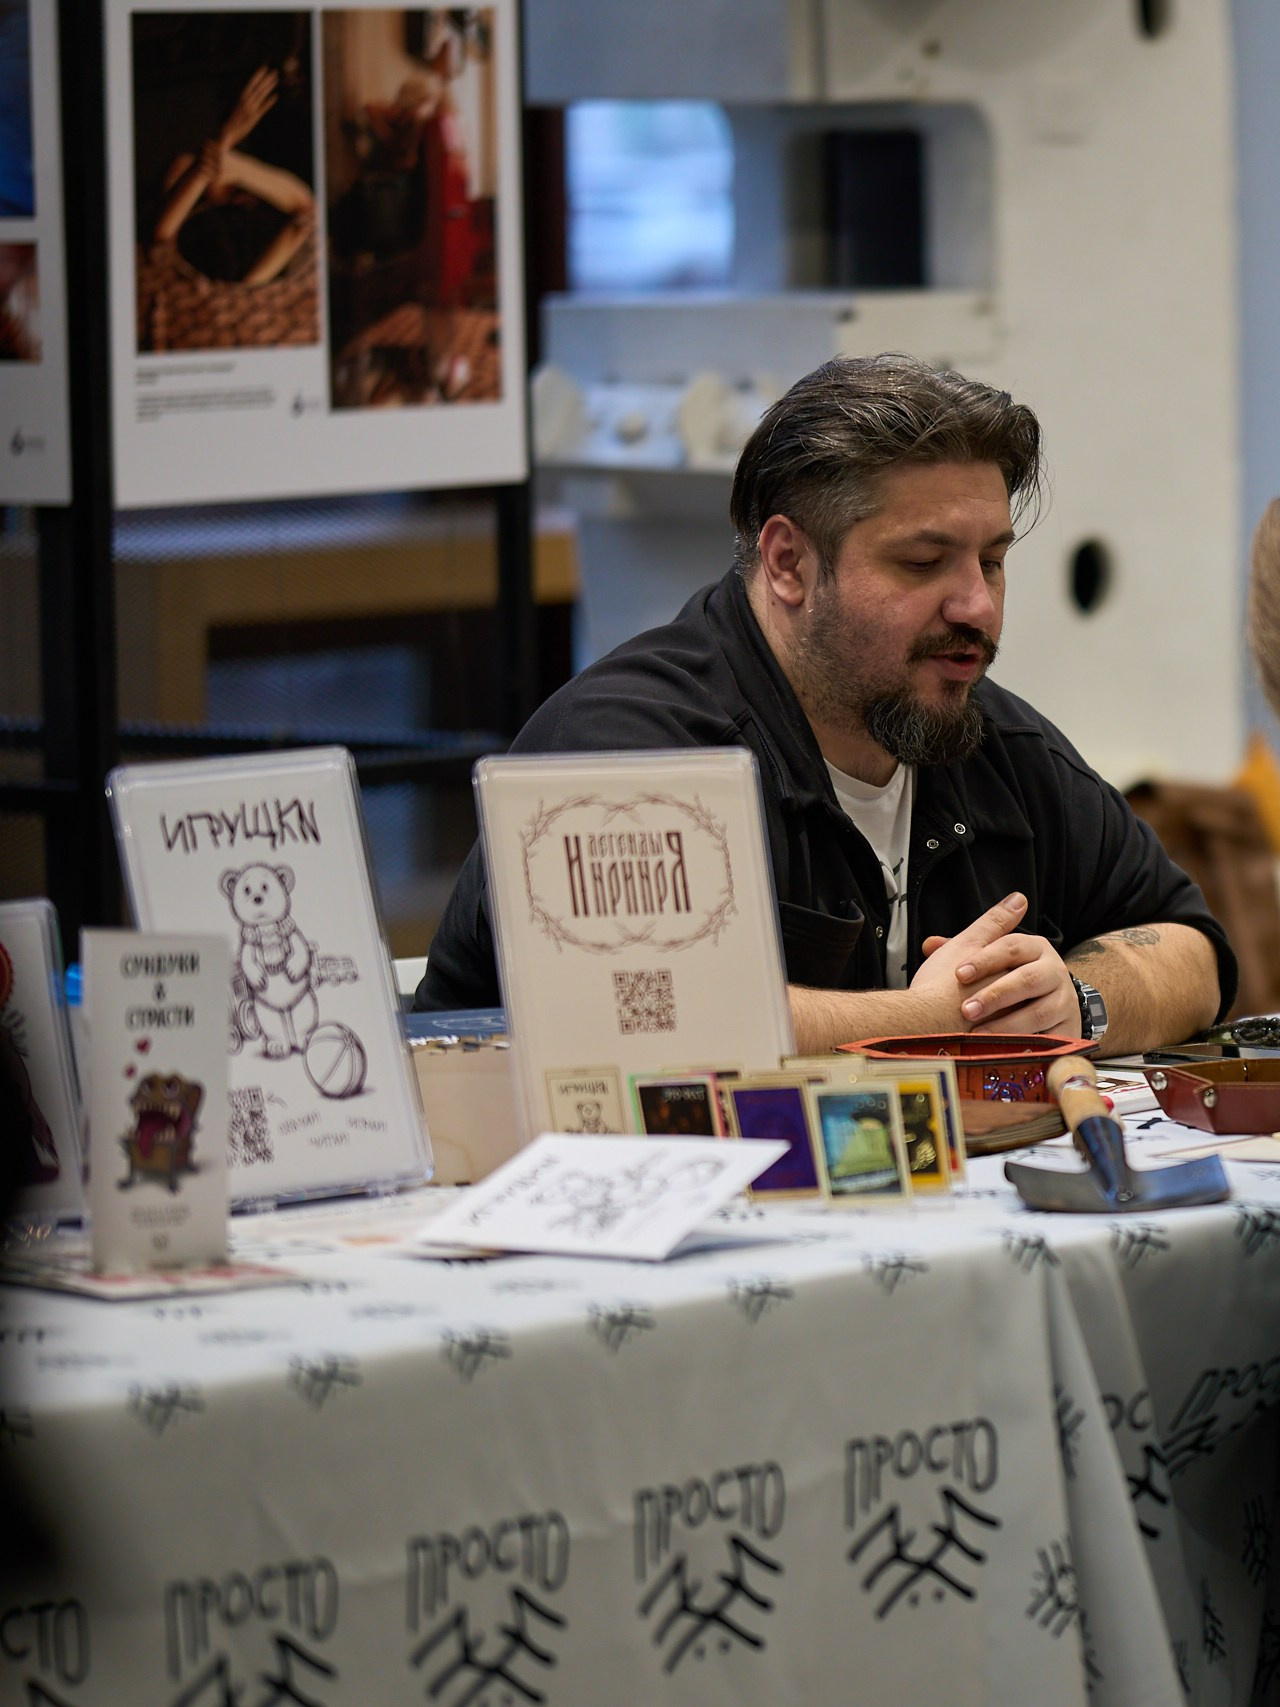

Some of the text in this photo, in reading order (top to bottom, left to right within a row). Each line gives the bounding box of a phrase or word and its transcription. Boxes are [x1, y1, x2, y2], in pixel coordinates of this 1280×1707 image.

[125, 1006, 195, 1030] СТРАСТИ
[634, 1461, 786, 1582] ПРОСТО
[845, 1418, 999, 1531] ПРОСТО
[164, 1556, 340, 1680] ПРОСТО
[406, 1510, 570, 1632] ПРОСТО
[0, 1597, 90, 1688] СТО
